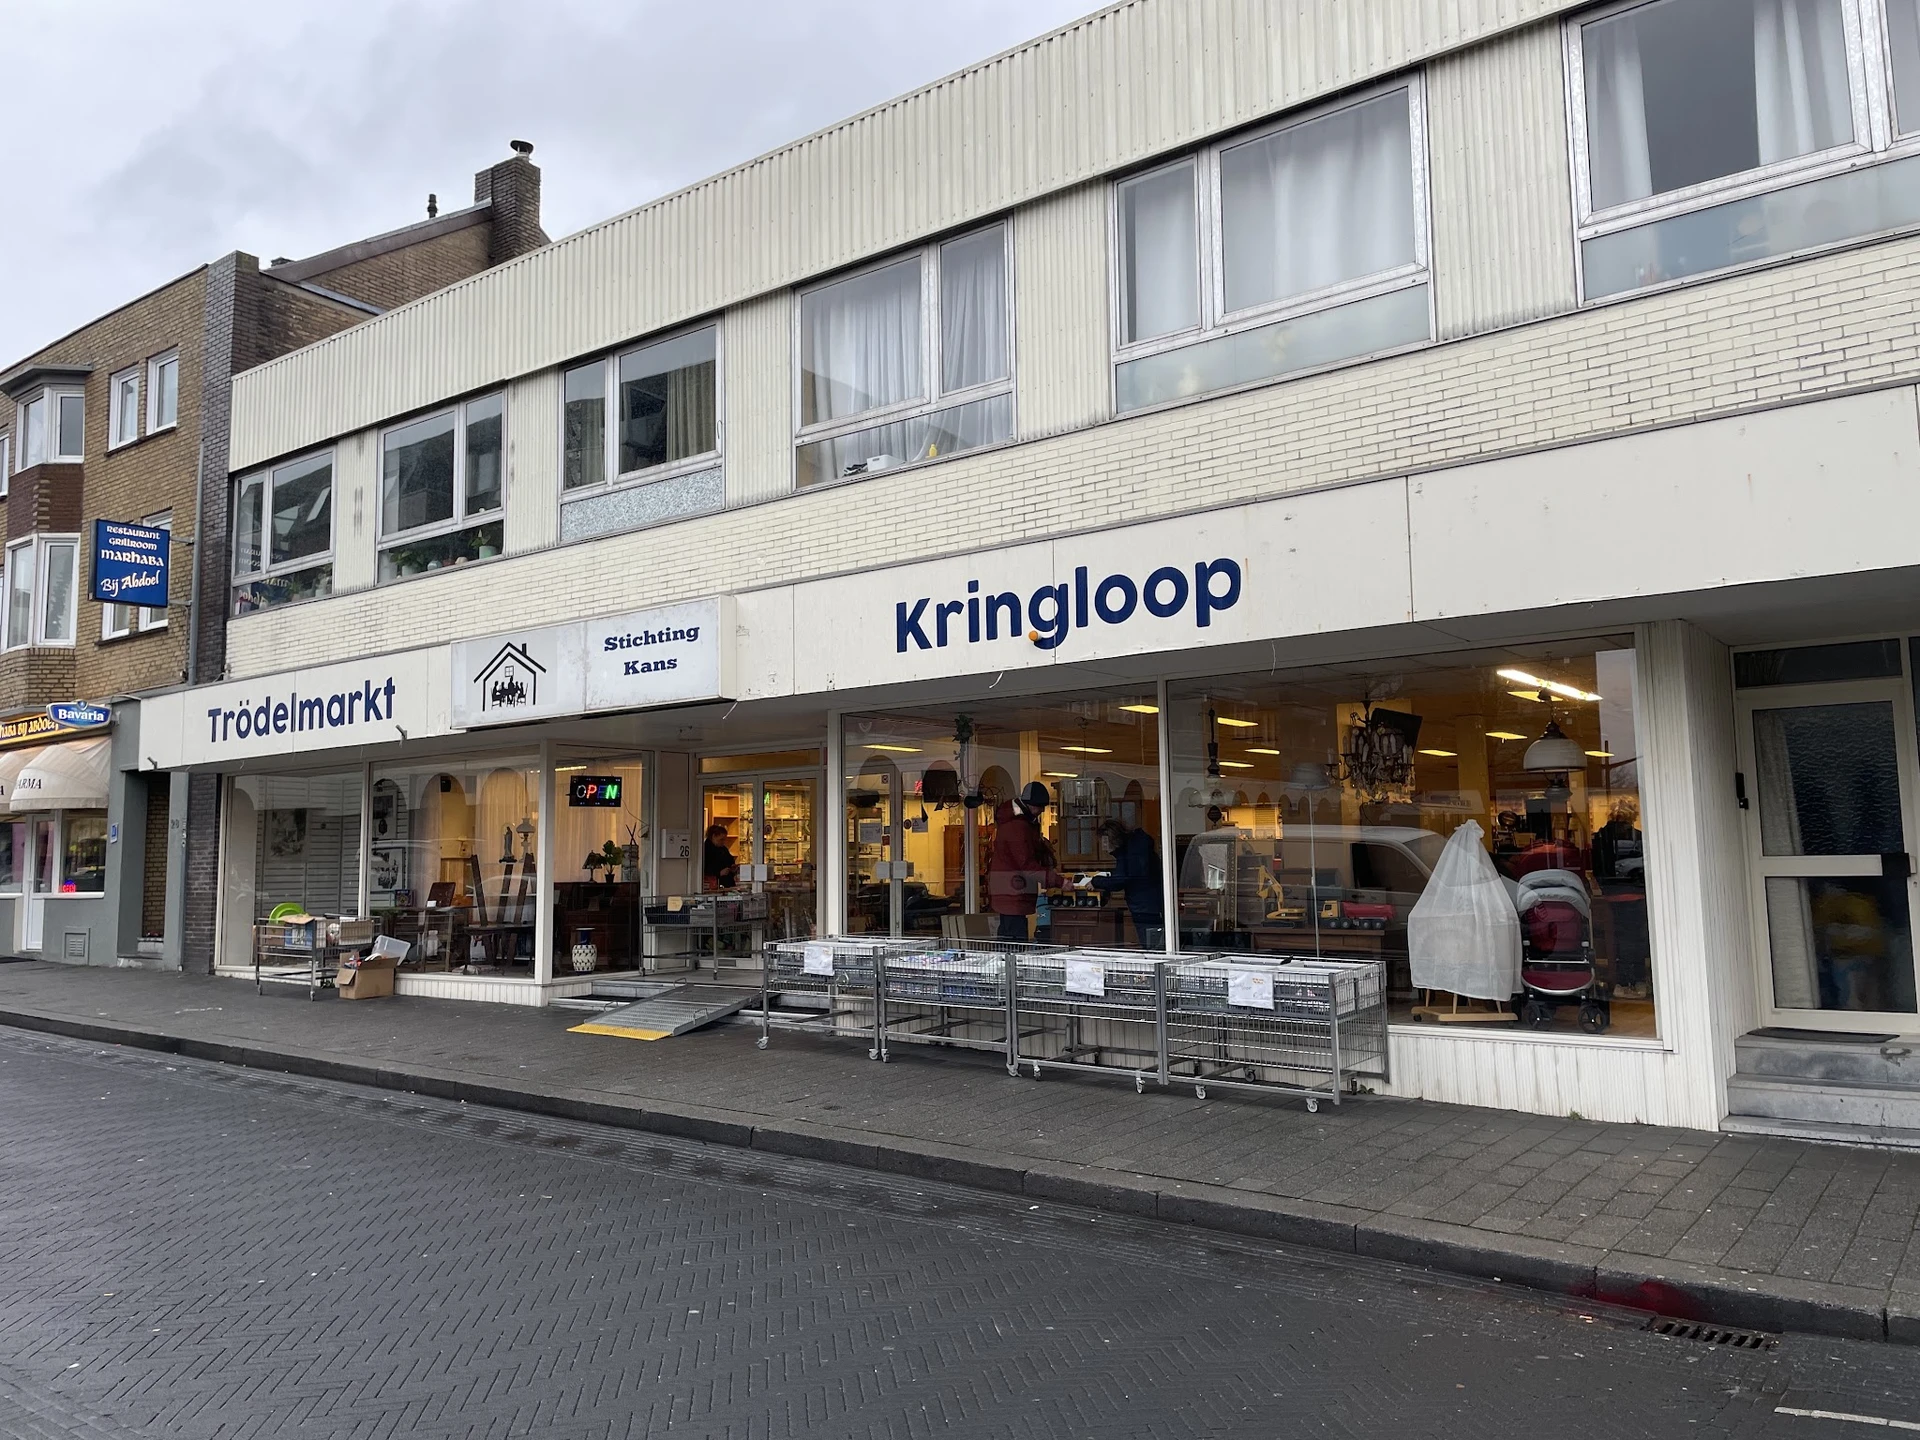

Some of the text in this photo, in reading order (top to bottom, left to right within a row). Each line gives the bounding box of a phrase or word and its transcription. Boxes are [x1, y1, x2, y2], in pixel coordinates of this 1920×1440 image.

[100, 569, 160, 597] Bij Abdoel
[896, 557, 1242, 653] Kringloop
[604, 626, 700, 651] Stichting
[623, 658, 678, 676] Kans
[58, 708, 105, 721] Bavaria
[208, 676, 396, 743] Trödelmarkt
[576, 784, 619, 800] OPEN
[680, 845, 690, 857] 26
